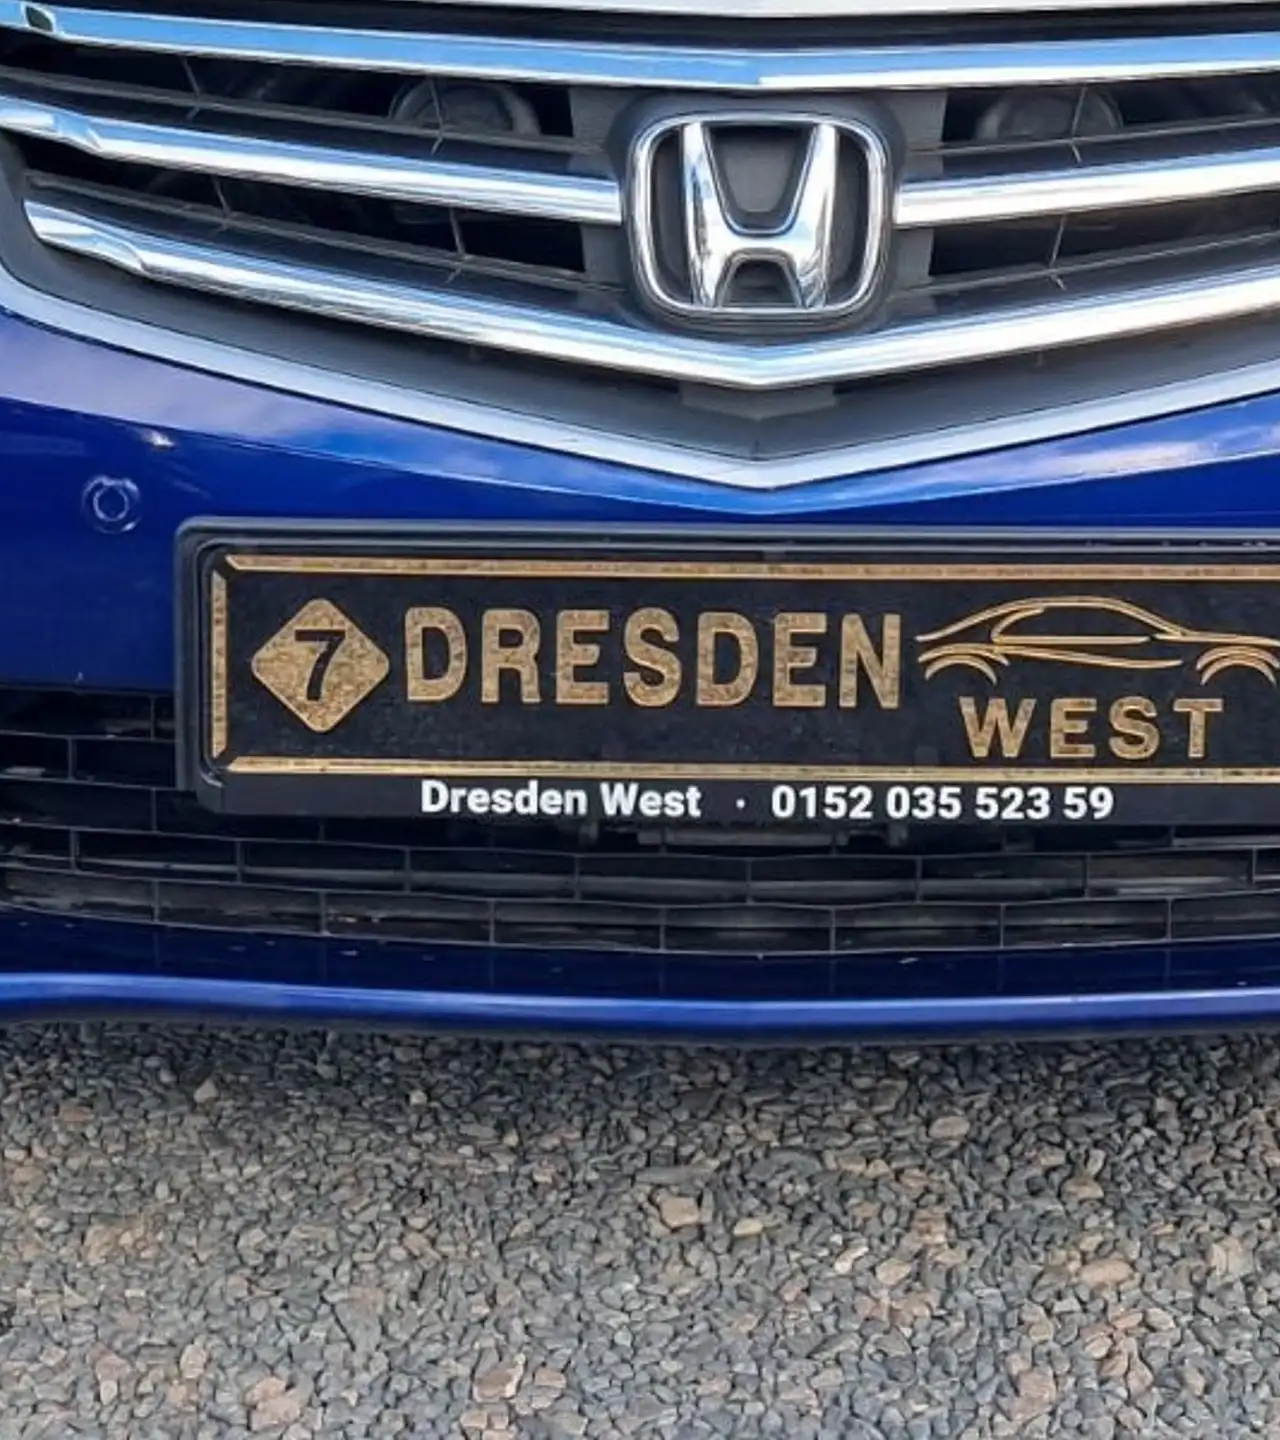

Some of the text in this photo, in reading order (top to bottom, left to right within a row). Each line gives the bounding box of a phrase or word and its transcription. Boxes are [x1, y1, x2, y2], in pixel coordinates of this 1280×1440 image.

[404, 606, 901, 709] DRESDEN
[959, 696, 1224, 759] WEST
[421, 780, 1114, 820] Dresden West 0152 035 523 59
